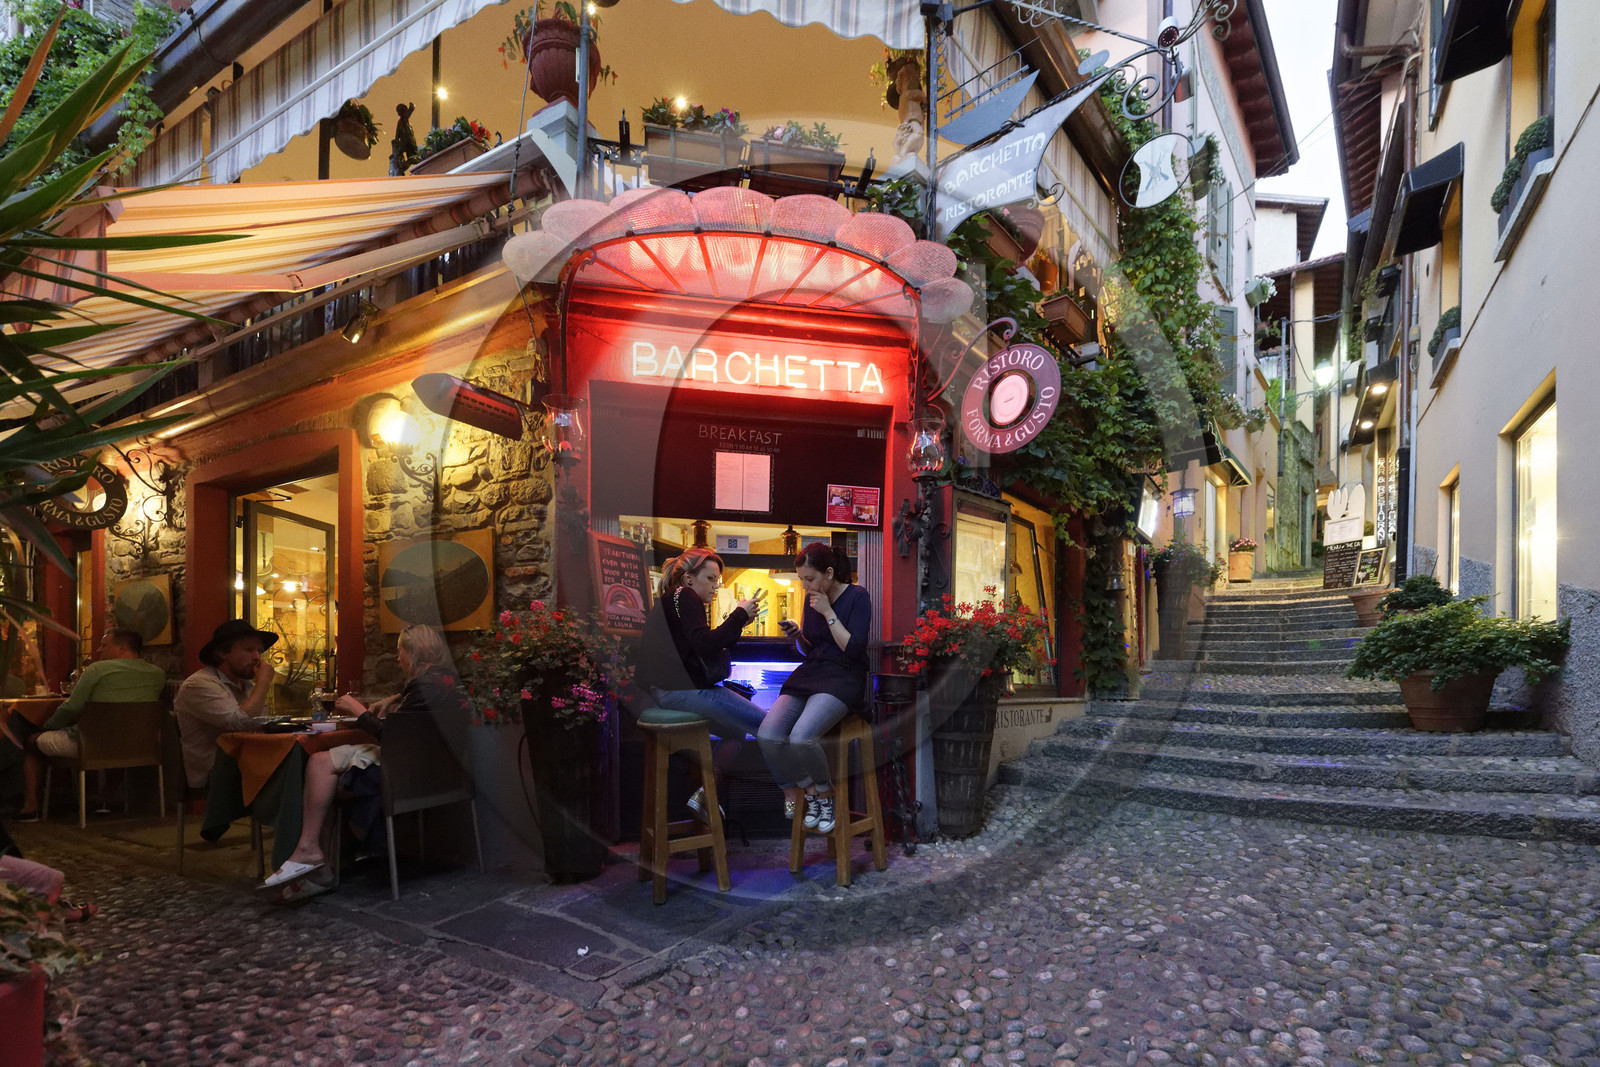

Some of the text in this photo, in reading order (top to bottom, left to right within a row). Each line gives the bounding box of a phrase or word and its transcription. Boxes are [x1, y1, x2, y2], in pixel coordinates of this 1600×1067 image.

[943, 131, 1047, 197] BARCHETTA
[631, 341, 884, 394] BARCHETTA
[973, 349, 1045, 391] RISTORO
[966, 386, 1056, 449] FORMA & GUSTO
[698, 424, 783, 445] BREAKFAST
[75, 516, 84, 526] &
[85, 498, 123, 527] GUSTO
[602, 558, 638, 570] OVEN WITH
[602, 568, 639, 580] WOOD FIRE
[621, 579, 640, 588] PIZZA
[614, 621, 633, 629] LEGNA
[994, 709, 1044, 729] RISTORANTE
